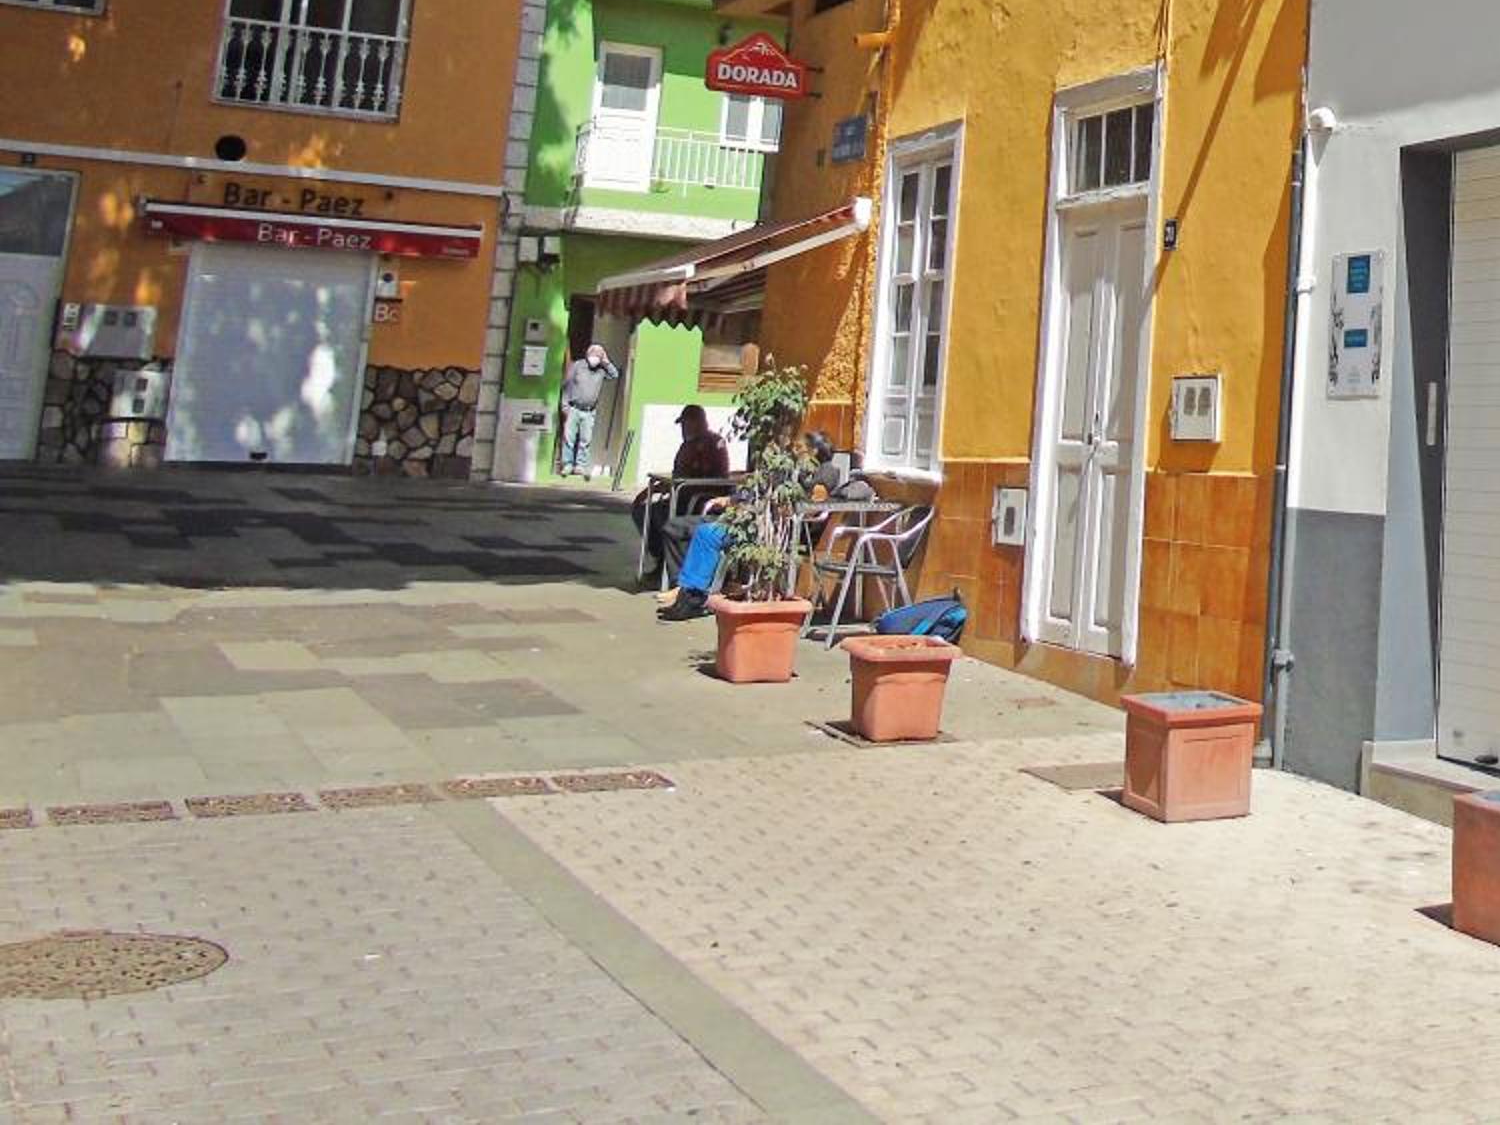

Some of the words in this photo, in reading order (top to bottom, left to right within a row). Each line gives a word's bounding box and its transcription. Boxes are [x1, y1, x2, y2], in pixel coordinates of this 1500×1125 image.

[717, 63, 798, 88] DORADA
[224, 182, 272, 208] Bar
[300, 188, 365, 217] Paez
[257, 223, 299, 246] Bar
[318, 228, 372, 251] Paez
